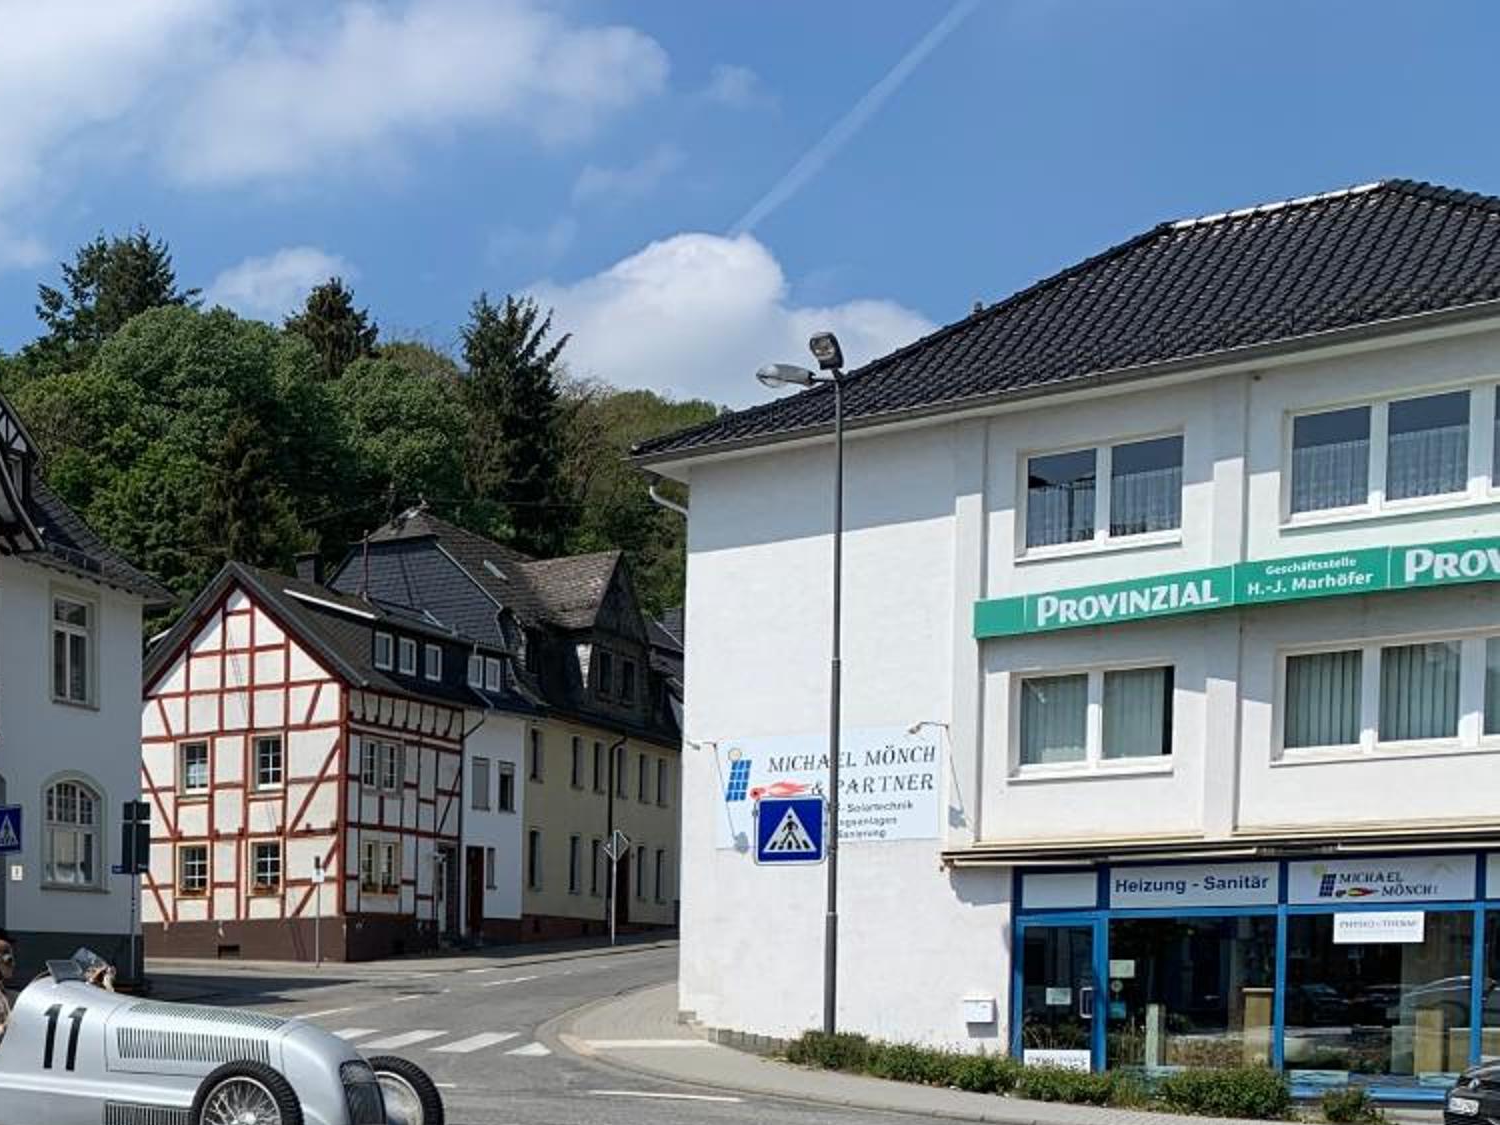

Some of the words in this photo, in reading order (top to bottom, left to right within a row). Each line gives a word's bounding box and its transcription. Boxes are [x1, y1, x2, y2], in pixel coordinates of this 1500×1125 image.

[1265, 556, 1357, 575] Geschäftsstelle
[1247, 580, 1287, 596] H.-J.
[1291, 571, 1374, 591] Marhöfer
[1036, 579, 1220, 627] PROVINZIAL
[767, 751, 857, 773] MICHAEL
[864, 745, 935, 767] MÖNCH
[1115, 879, 1187, 895] Heizung
[1203, 875, 1270, 891] Sanitär
[1339, 871, 1405, 884] MICHAEL
[43, 1003, 88, 1072] 11
